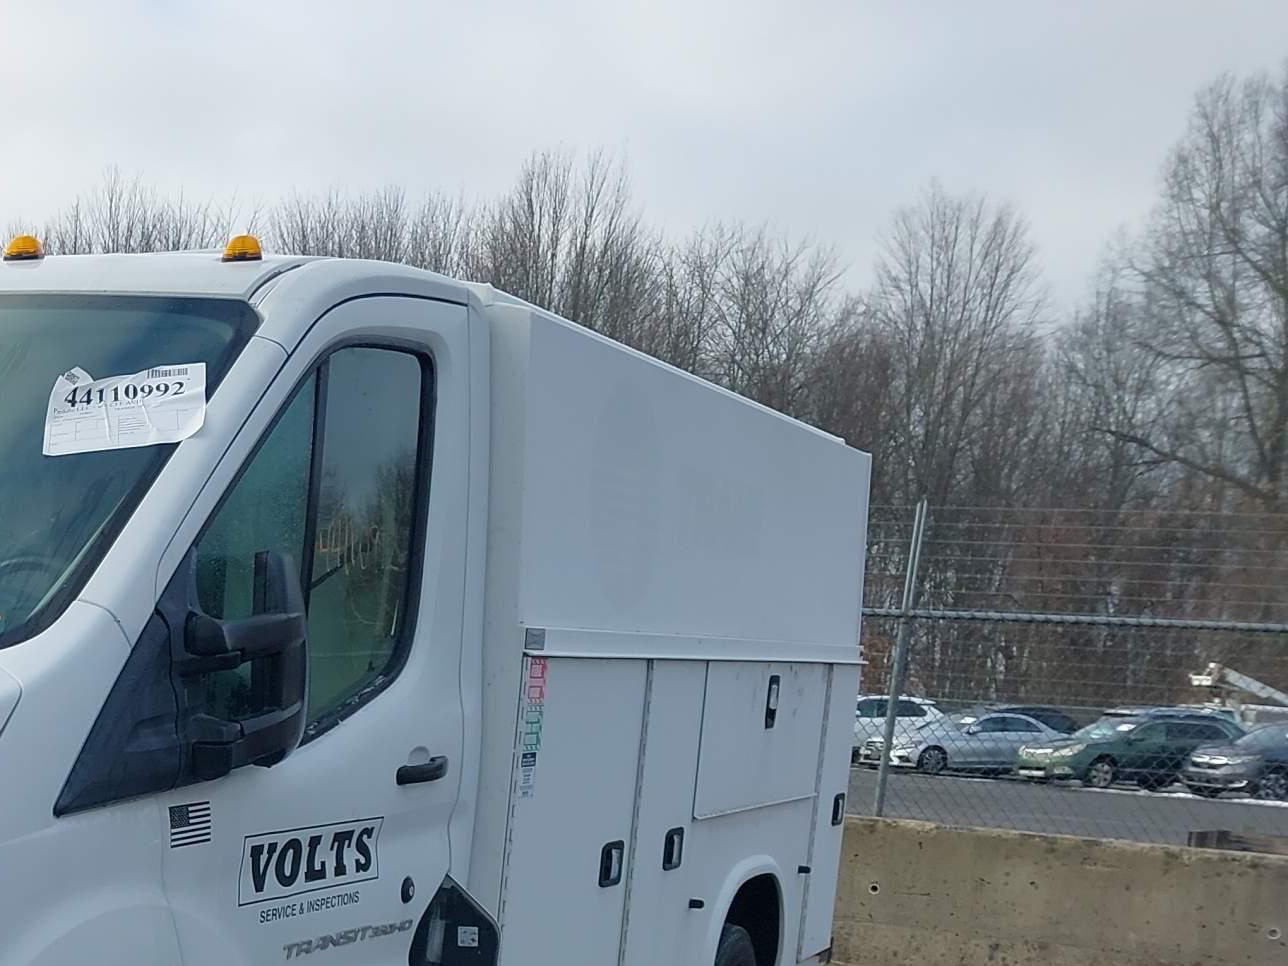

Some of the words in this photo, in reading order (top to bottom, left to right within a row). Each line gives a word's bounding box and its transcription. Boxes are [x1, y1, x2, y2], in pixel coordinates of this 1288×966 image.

[64, 381, 185, 408] 44110992
[250, 827, 375, 893] VOLTS
[259, 907, 297, 923] SERVICE
[298, 903, 305, 915] &
[307, 891, 360, 913] INSPECTIONS
